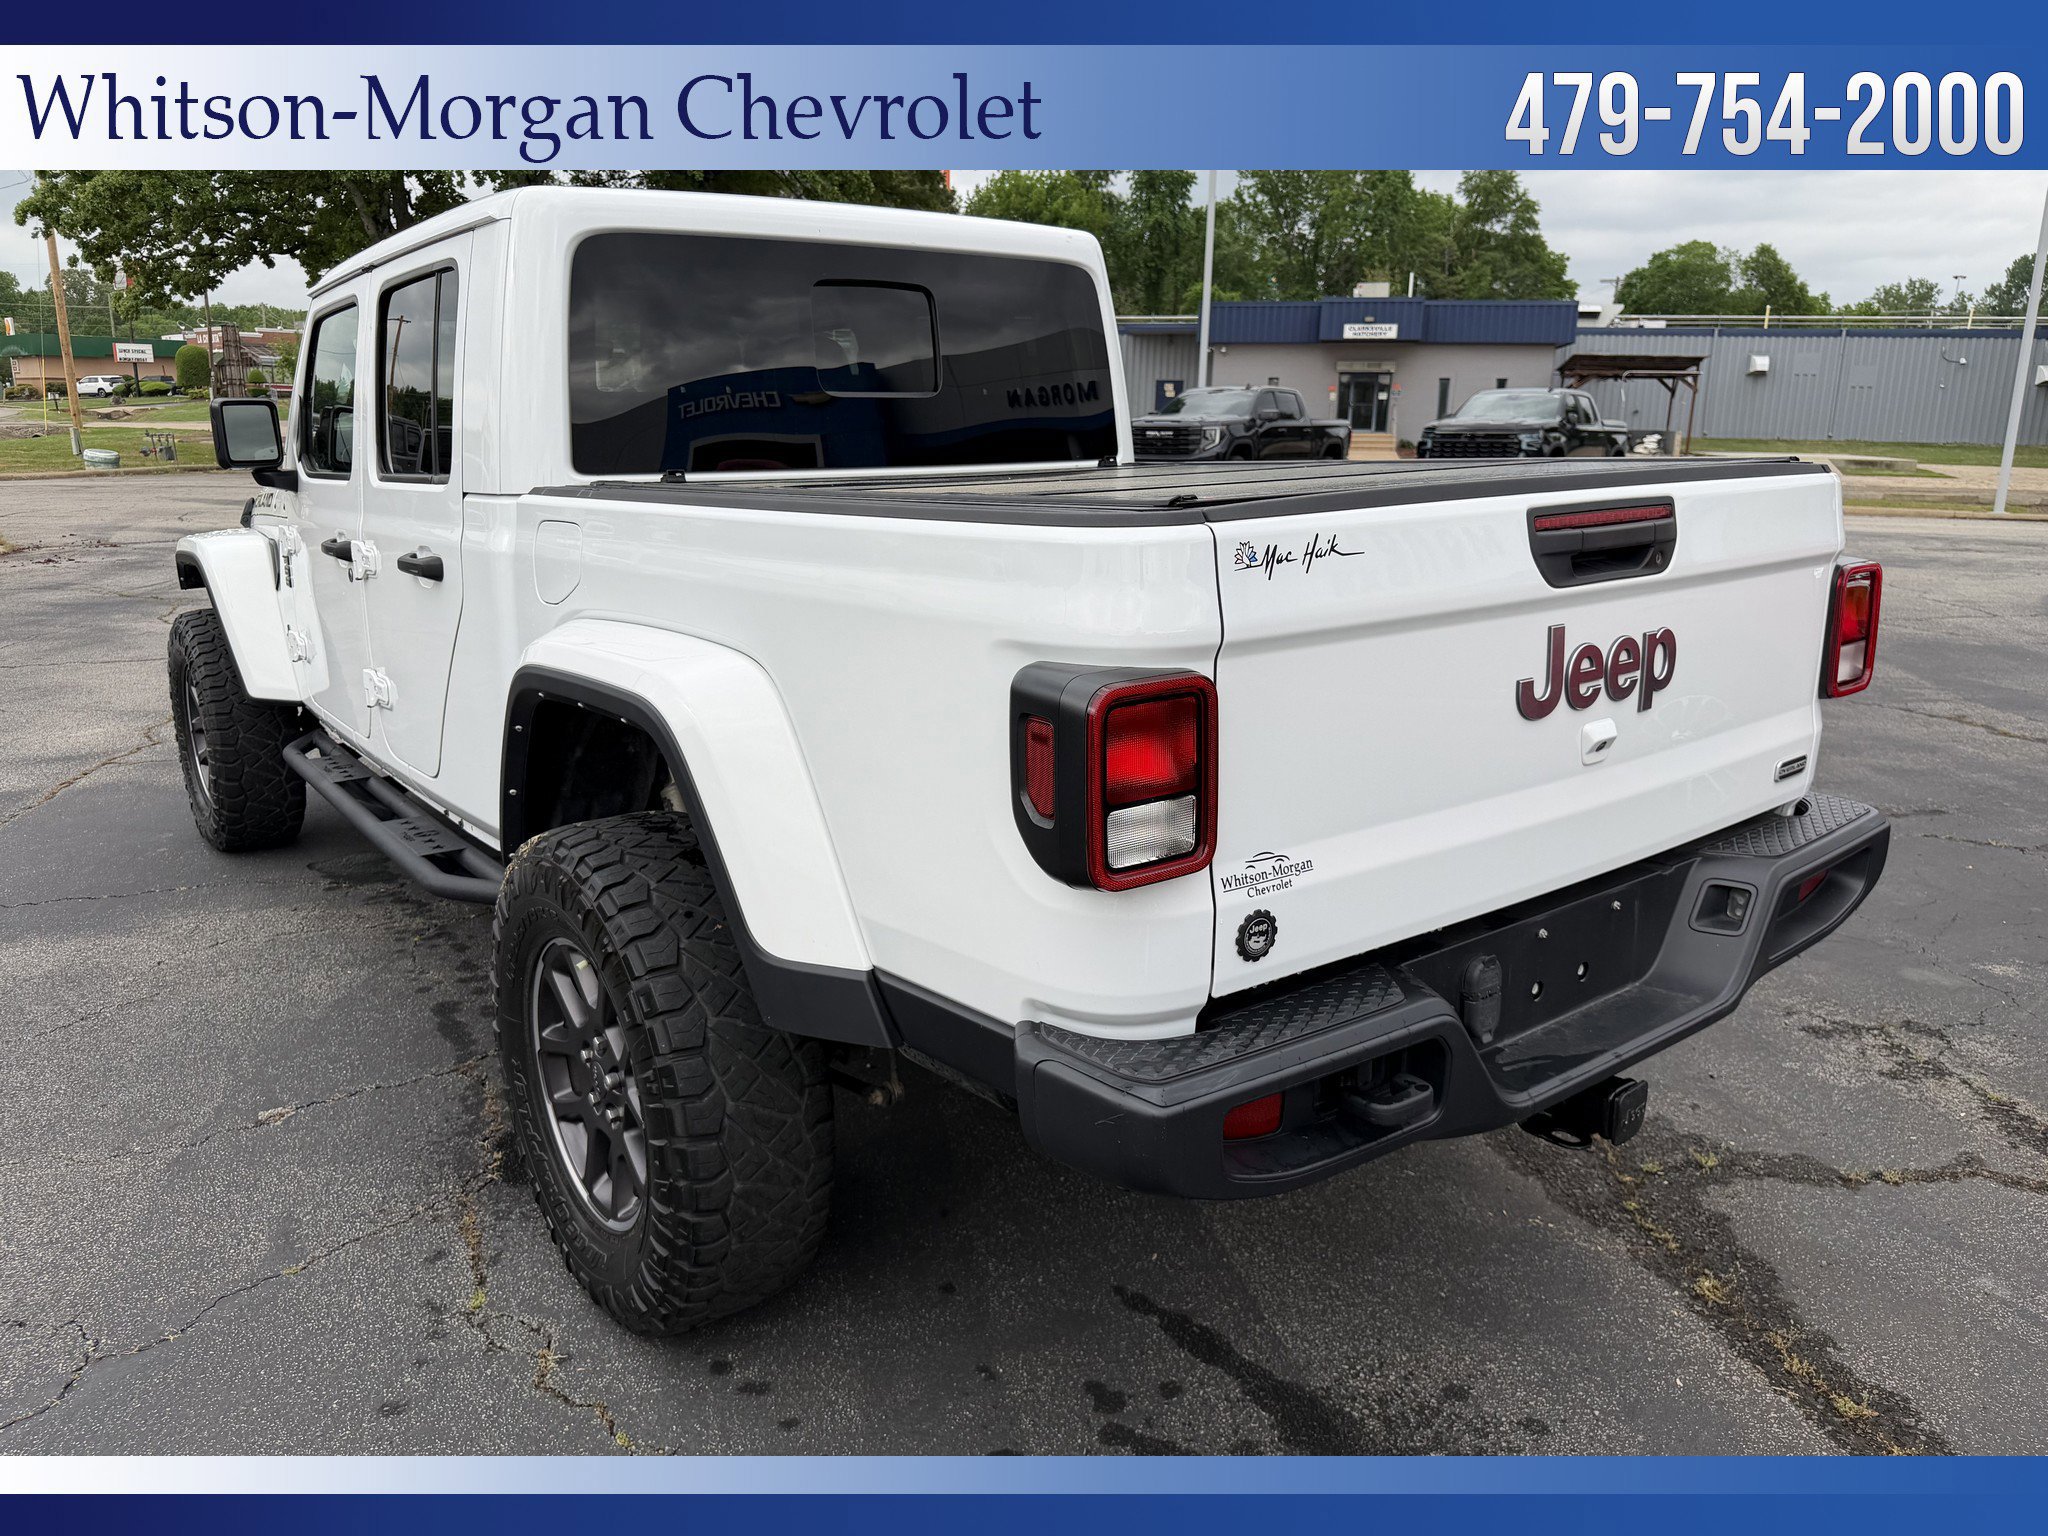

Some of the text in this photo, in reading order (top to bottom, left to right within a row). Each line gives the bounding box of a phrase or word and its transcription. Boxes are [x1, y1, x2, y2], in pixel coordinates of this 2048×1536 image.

[1260, 533, 1365, 580] Mac Haik
[1515, 623, 1677, 722] Jeep
[1220, 859, 1313, 892] Whitson-Morgan
[1246, 878, 1293, 899] Chevrolet
[1249, 923, 1268, 934] Jeep
